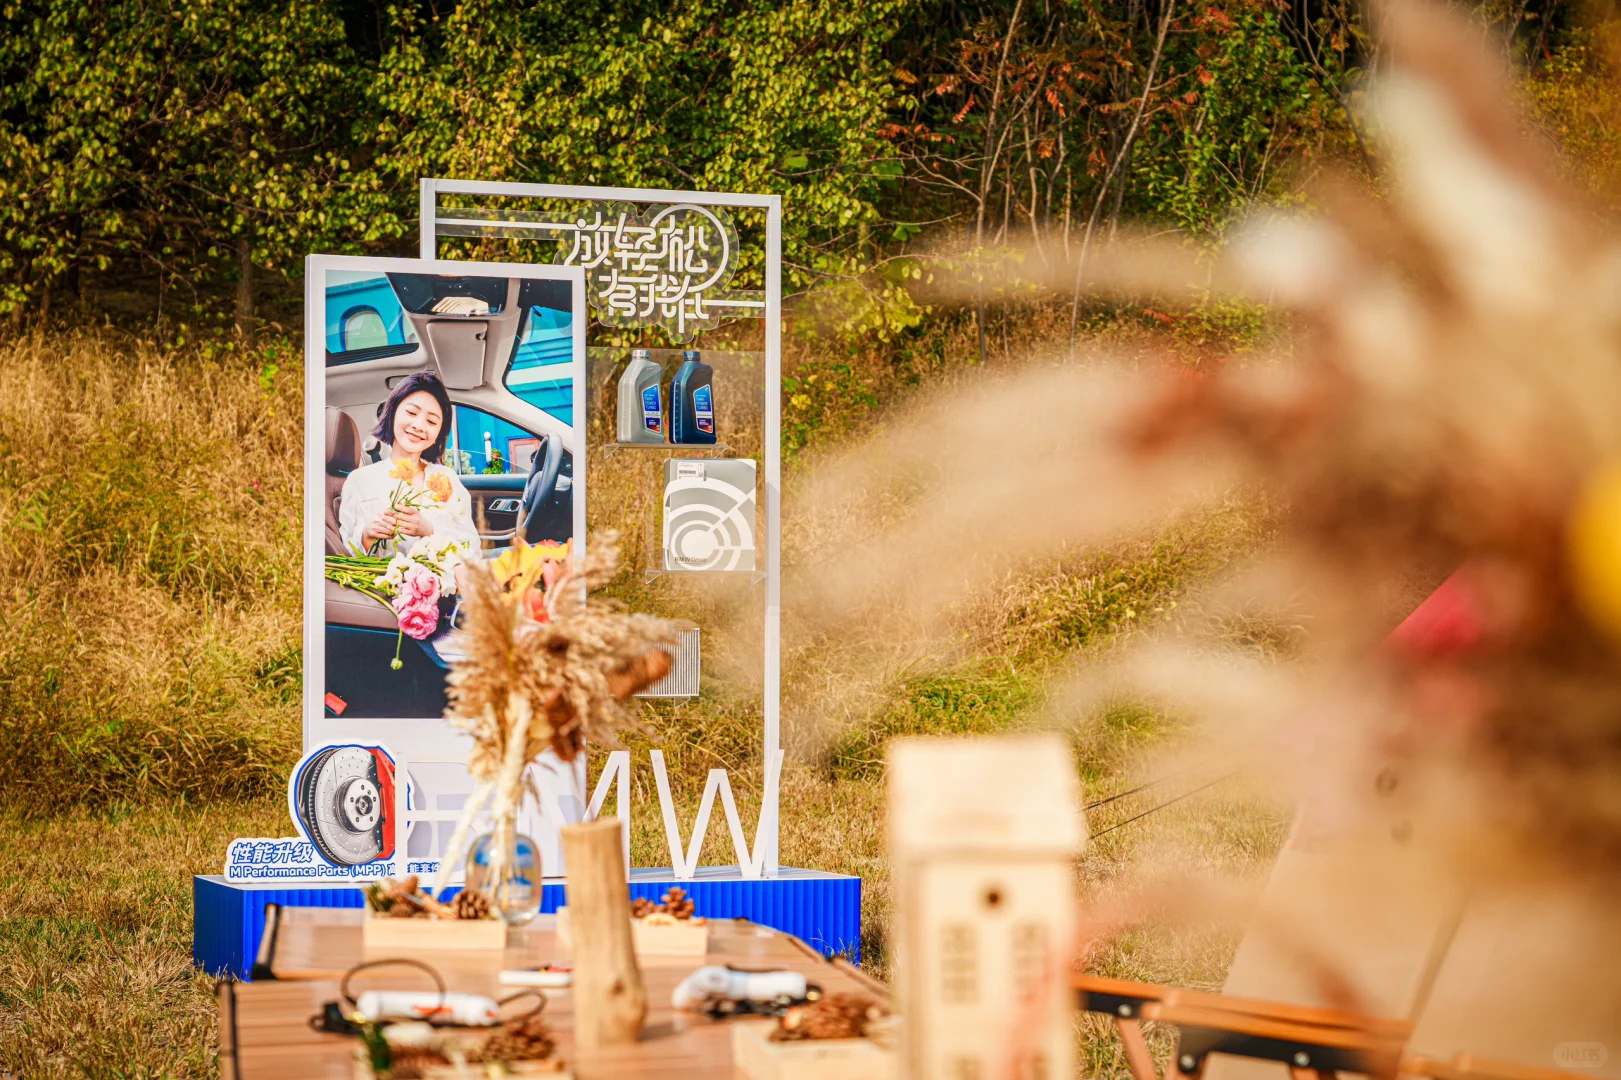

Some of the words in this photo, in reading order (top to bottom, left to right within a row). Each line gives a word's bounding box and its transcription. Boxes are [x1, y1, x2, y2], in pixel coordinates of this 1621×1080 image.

[232, 842, 314, 864] 性能升级
[230, 866, 242, 878] M
[243, 865, 317, 878] Performance
[318, 864, 350, 877] Parts
[351, 864, 387, 878] (MPP)
